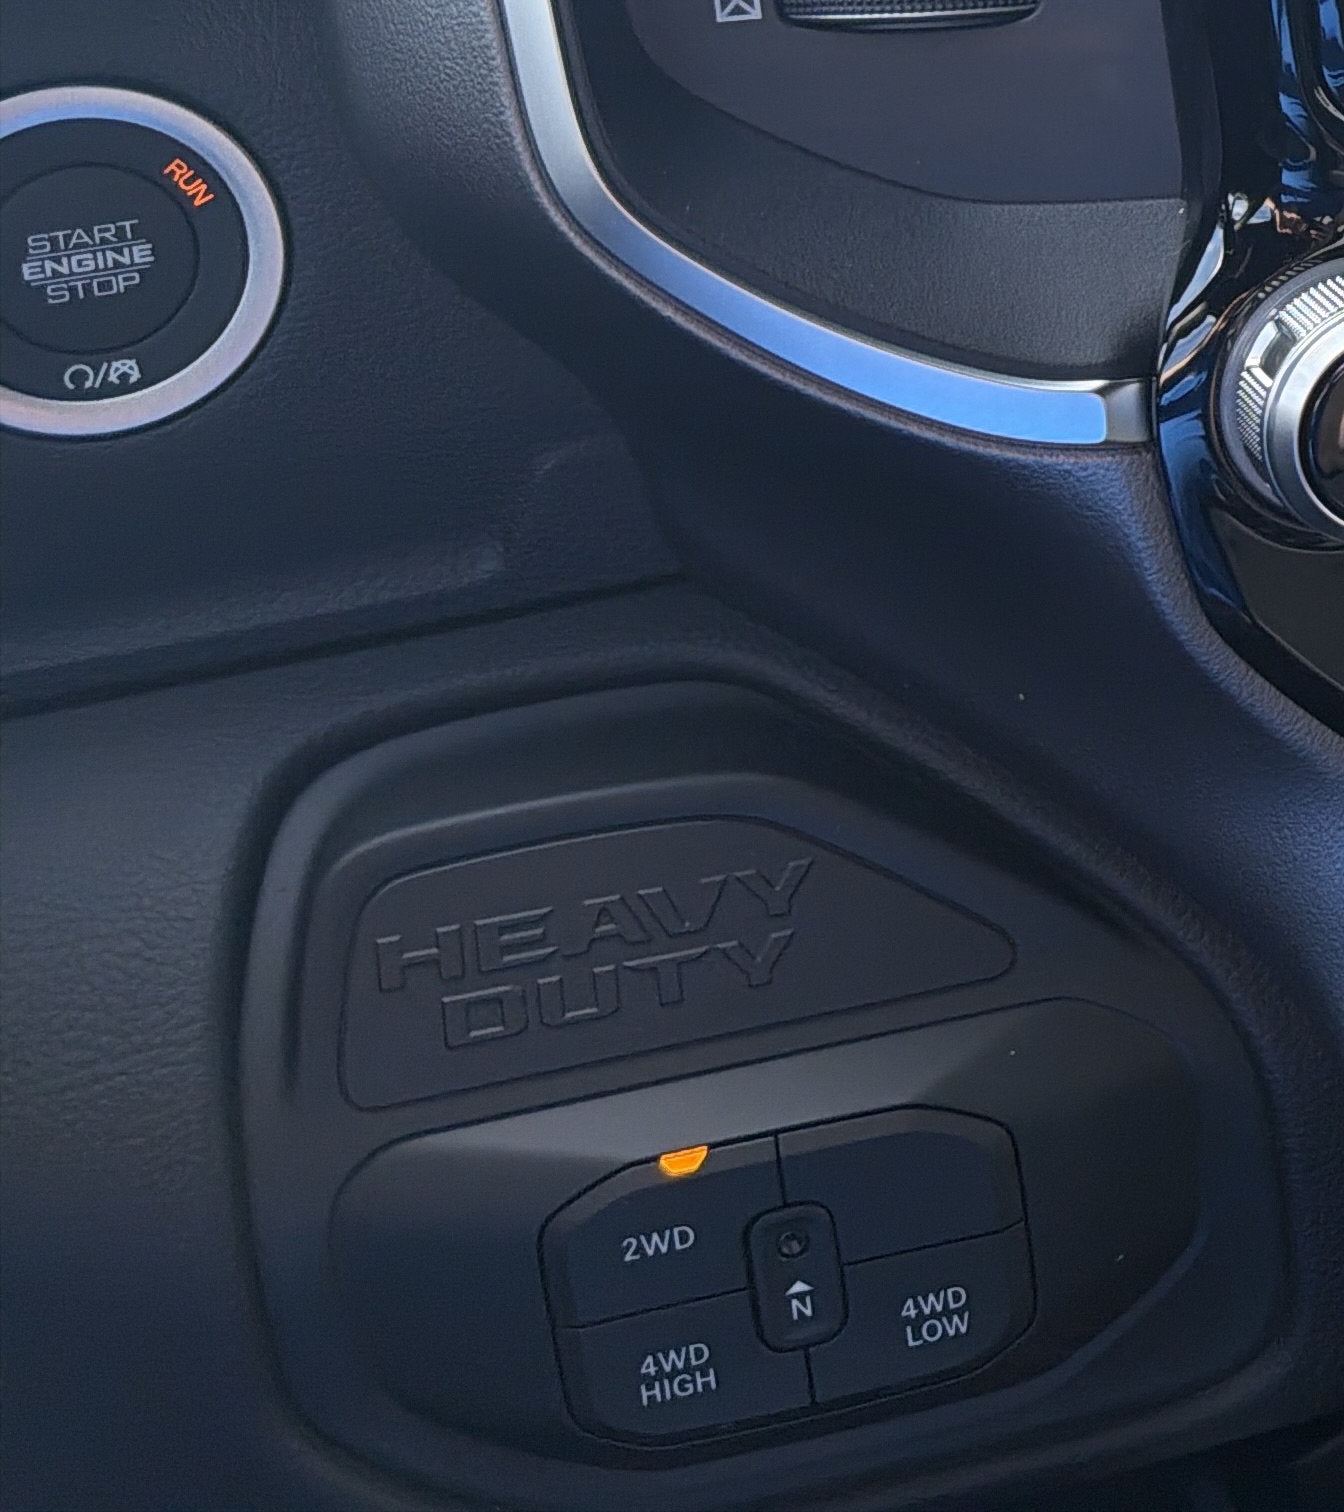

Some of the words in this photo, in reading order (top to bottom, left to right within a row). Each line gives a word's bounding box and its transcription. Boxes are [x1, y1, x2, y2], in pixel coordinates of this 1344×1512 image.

[164, 158, 214, 208] RUN
[27, 219, 139, 254] START
[22, 243, 155, 282] ENGINE
[47, 271, 140, 304] STOP
[376, 856, 815, 993] HEAVY
[441, 927, 794, 1051] DUTY
[622, 1224, 695, 1262] 2WD
[791, 1295, 813, 1320] N
[901, 1286, 967, 1320] 4WD
[906, 1311, 970, 1348] LOW
[640, 1342, 710, 1377] 4WD
[640, 1368, 717, 1408] HIGH
